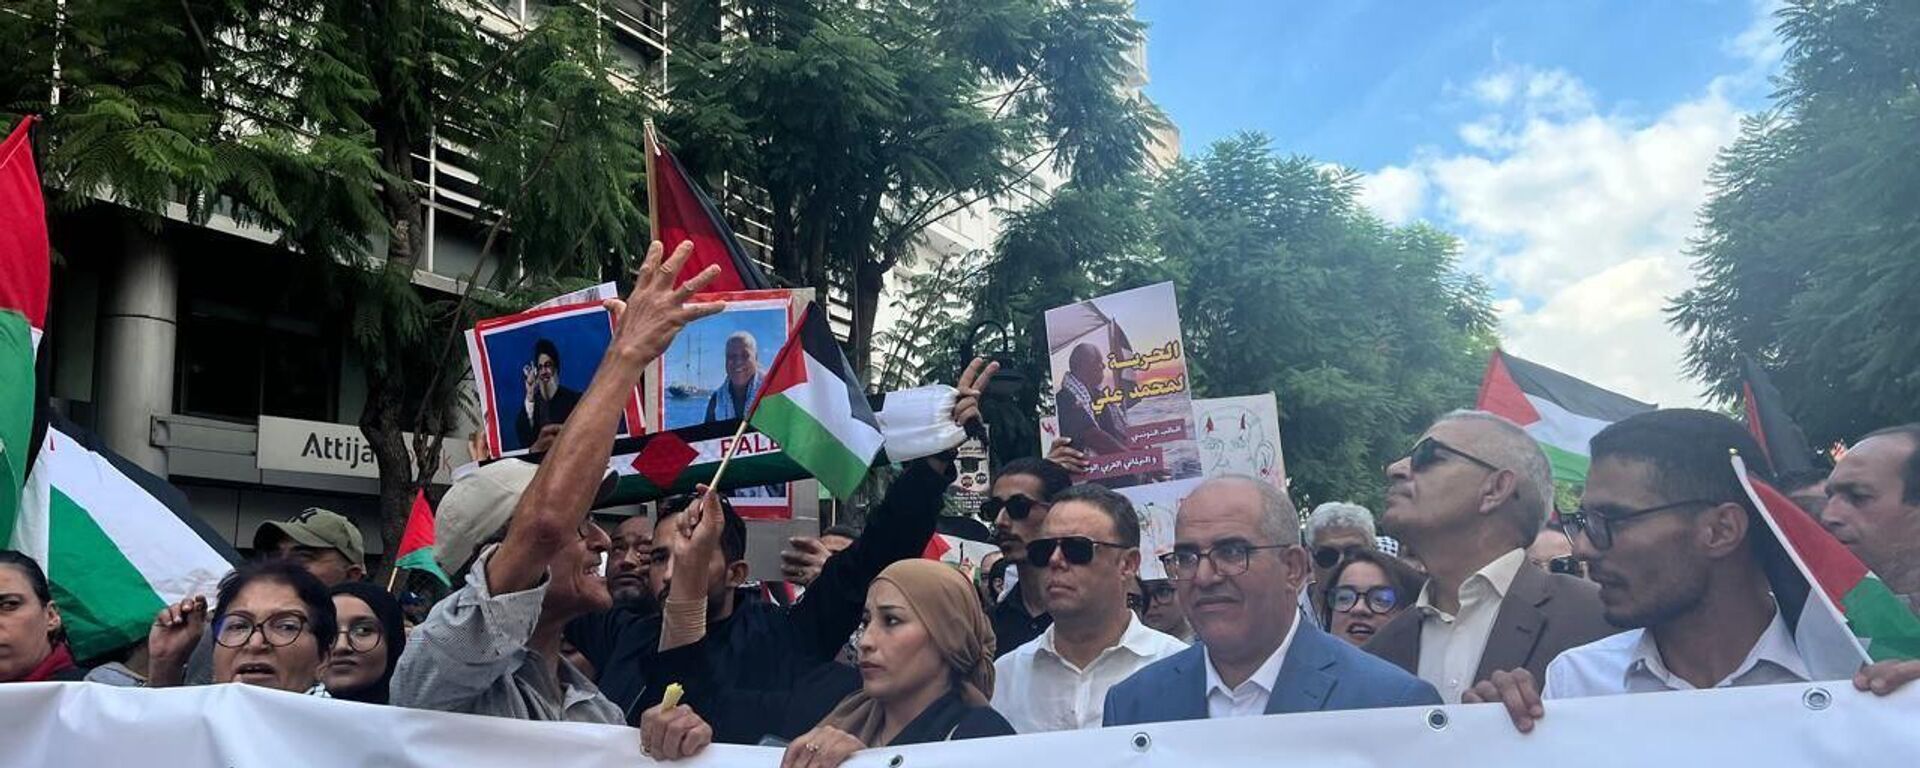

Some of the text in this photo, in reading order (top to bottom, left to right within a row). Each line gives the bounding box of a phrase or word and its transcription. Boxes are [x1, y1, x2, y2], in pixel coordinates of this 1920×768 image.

[1107, 340, 1180, 370] الحرية
[1091, 373, 1185, 415] لمحمد علي
[301, 432, 375, 469] Attija
